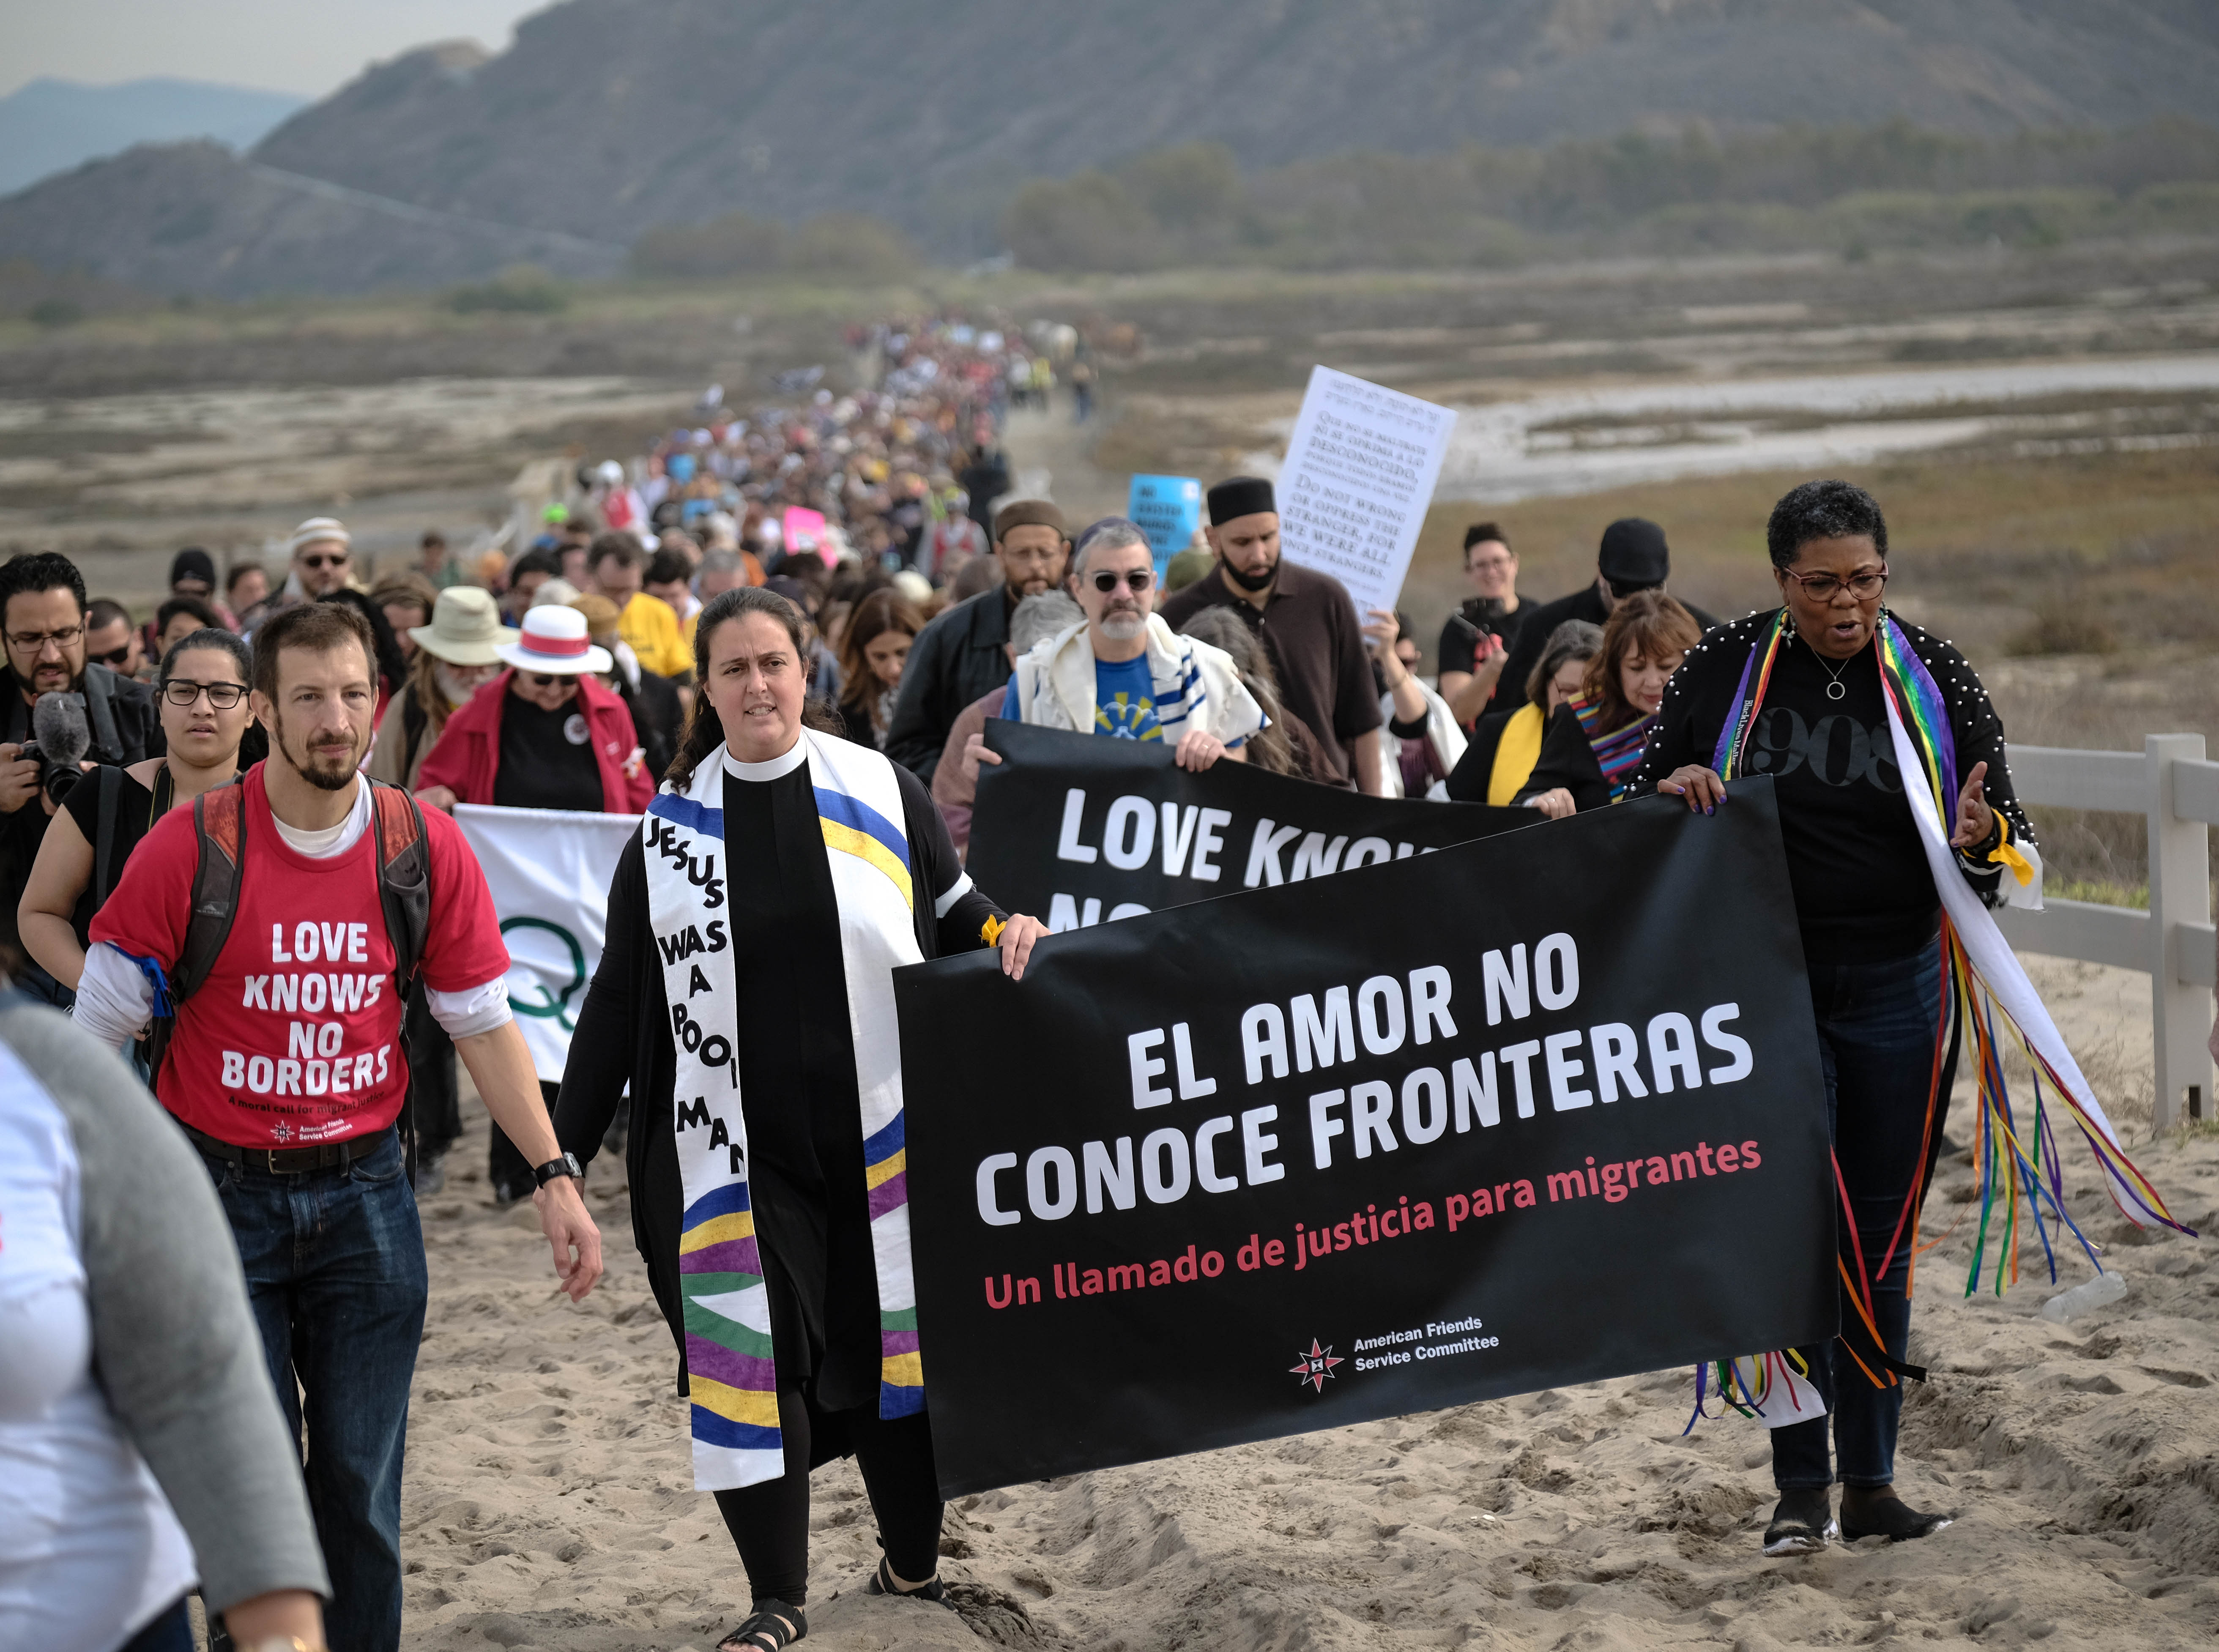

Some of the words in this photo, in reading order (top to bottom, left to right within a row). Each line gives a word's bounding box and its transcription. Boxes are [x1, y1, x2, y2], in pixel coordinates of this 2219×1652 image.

[1314, 424, 1328, 435] NI
[1331, 430, 1343, 440] SE
[1346, 422, 1361, 432] NO
[1364, 428, 1373, 437] SE
[1291, 491, 1311, 506] OR
[1313, 499, 1372, 527] OPPRESS
[1374, 520, 1402, 537] THE
[1323, 486, 1352, 504] NOT
[1355, 497, 1407, 522] WRONG
[1282, 520, 1308, 537] WE
[1312, 530, 1359, 554] WERE
[1361, 546, 1393, 566] ALL
[1285, 505, 1365, 540] STRANGER,
[1366, 532, 1397, 550] FOR
[1742, 700, 1753, 719] Black
[1732, 739, 1740, 766] Matter
[1058, 789, 1231, 881] LOVE
[645, 818, 724, 908] JESUS
[1048, 893, 1151, 934] N
[273, 922, 367, 962] LOVE
[658, 921, 727, 965] WAS
[243, 974, 386, 1012] KNOWS
[690, 964, 712, 998] A
[289, 1022, 343, 1058] NO
[1128, 1023, 1216, 1109] EL
[1242, 965, 1458, 1084] AMOR
[1483, 933, 1579, 1026] NO
[222, 1045, 390, 1095] BORDERS
[228, 1097, 235, 1105] A
[238, 1102, 270, 1112] moral
[274, 1105, 293, 1114] call
[298, 1105, 313, 1114] for
[317, 1102, 356, 1115] migrant
[357, 1091, 384, 1108] justice
[977, 1105, 1285, 1225] CONOCE
[1310, 1003, 1753, 1169] FRONTERAS
[324, 1124, 353, 1137] Committee
[328, 1119, 344, 1128] Friends
[985, 1274, 1041, 1309] Un
[1054, 1244, 1224, 1299] llamado
[1237, 1234, 1285, 1271] de
[1294, 1196, 1435, 1270] justicia
[1446, 1179, 1536, 1232] para
[1547, 1141, 1761, 1202] migrantes
[1354, 1329, 1423, 1352] American
[1426, 1316, 1483, 1337] Friends
[1356, 1352, 1411, 1371] Service
[1415, 1336, 1499, 1360] Committee
